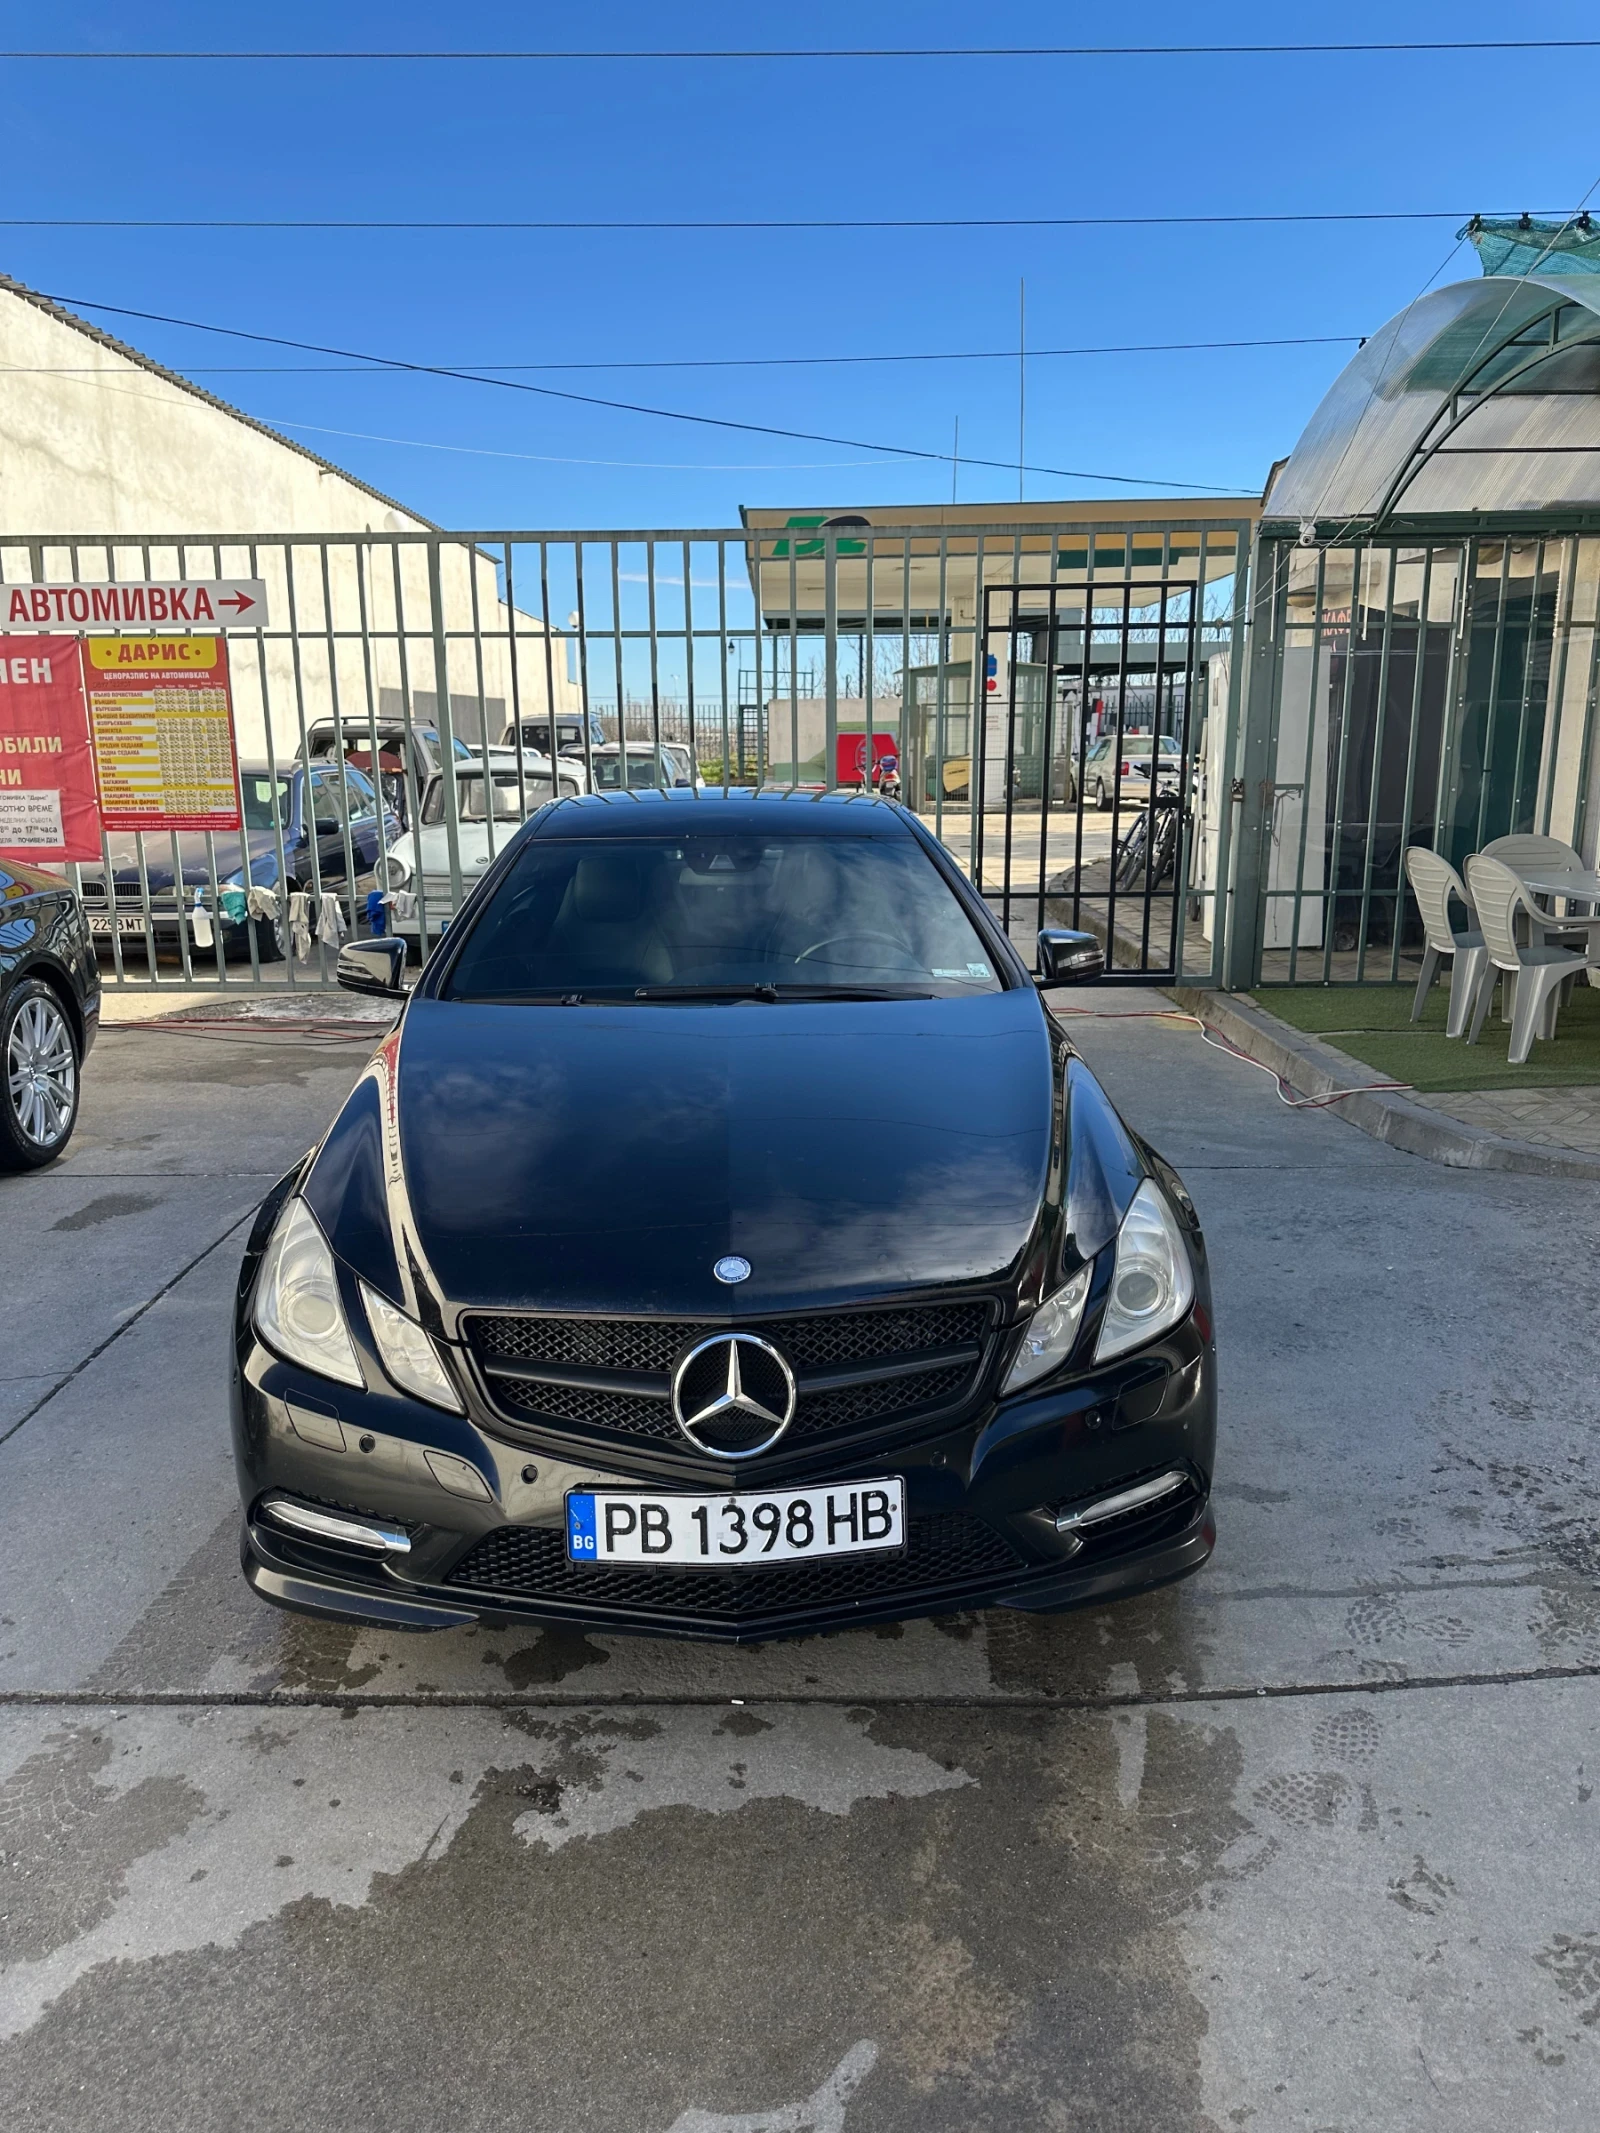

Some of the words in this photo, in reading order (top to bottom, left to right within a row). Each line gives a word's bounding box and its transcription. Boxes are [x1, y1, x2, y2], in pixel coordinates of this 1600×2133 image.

[9, 587, 215, 622] АВТОМИВКА
[118, 643, 191, 663] ДАРИС
[103, 672, 149, 681] ЦЕНОРАЗПИС
[151, 672, 160, 680] НА
[162, 671, 210, 680] АВТОМИВКАТА
[28, 804, 53, 813] ВРЕМЕ
[40, 826, 58, 834] часа
[125, 918, 143, 931] MT
[605, 1502, 673, 1554] PB
[691, 1498, 815, 1556] 1398
[826, 1489, 893, 1545] HB
[573, 1535, 595, 1550] BG
